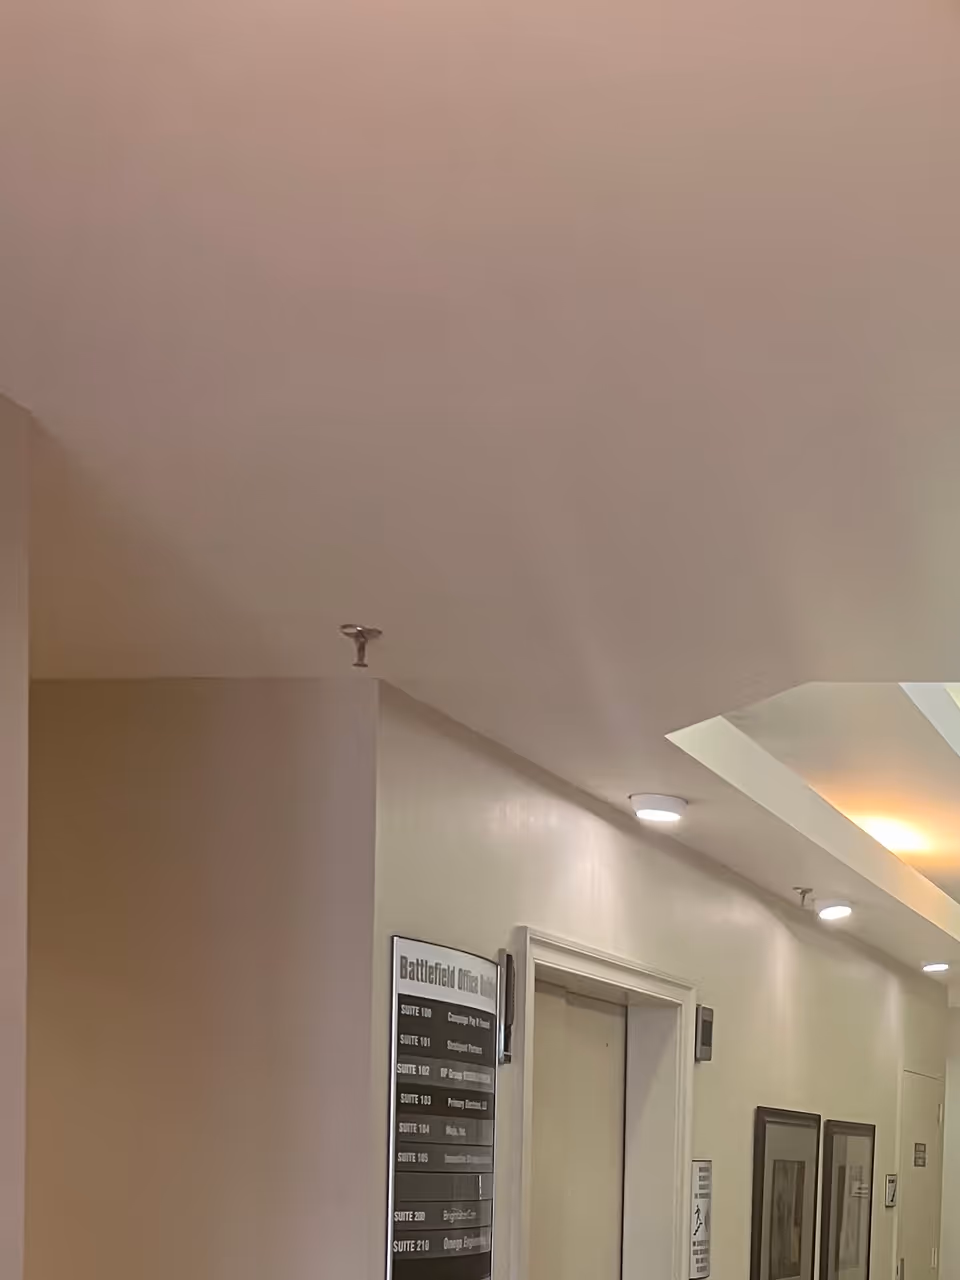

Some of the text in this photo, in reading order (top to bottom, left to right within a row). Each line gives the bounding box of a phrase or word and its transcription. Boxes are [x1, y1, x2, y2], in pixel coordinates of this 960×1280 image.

[400, 955, 456, 989] Battlefield
[400, 1004, 420, 1017] SUITE
[421, 1007, 432, 1019] 100
[400, 1034, 419, 1047] SUITE
[420, 1037, 431, 1047] 101
[396, 1063, 417, 1076] SUITE
[418, 1065, 430, 1076] 102
[400, 1093, 419, 1105] SUITE
[420, 1095, 432, 1106] 103
[398, 1122, 430, 1134] SUITE 104
[397, 1152, 429, 1163] SUITE 105
[394, 1211, 413, 1222] SUITE
[393, 1240, 415, 1253] SUITE
[416, 1239, 430, 1252] 210
